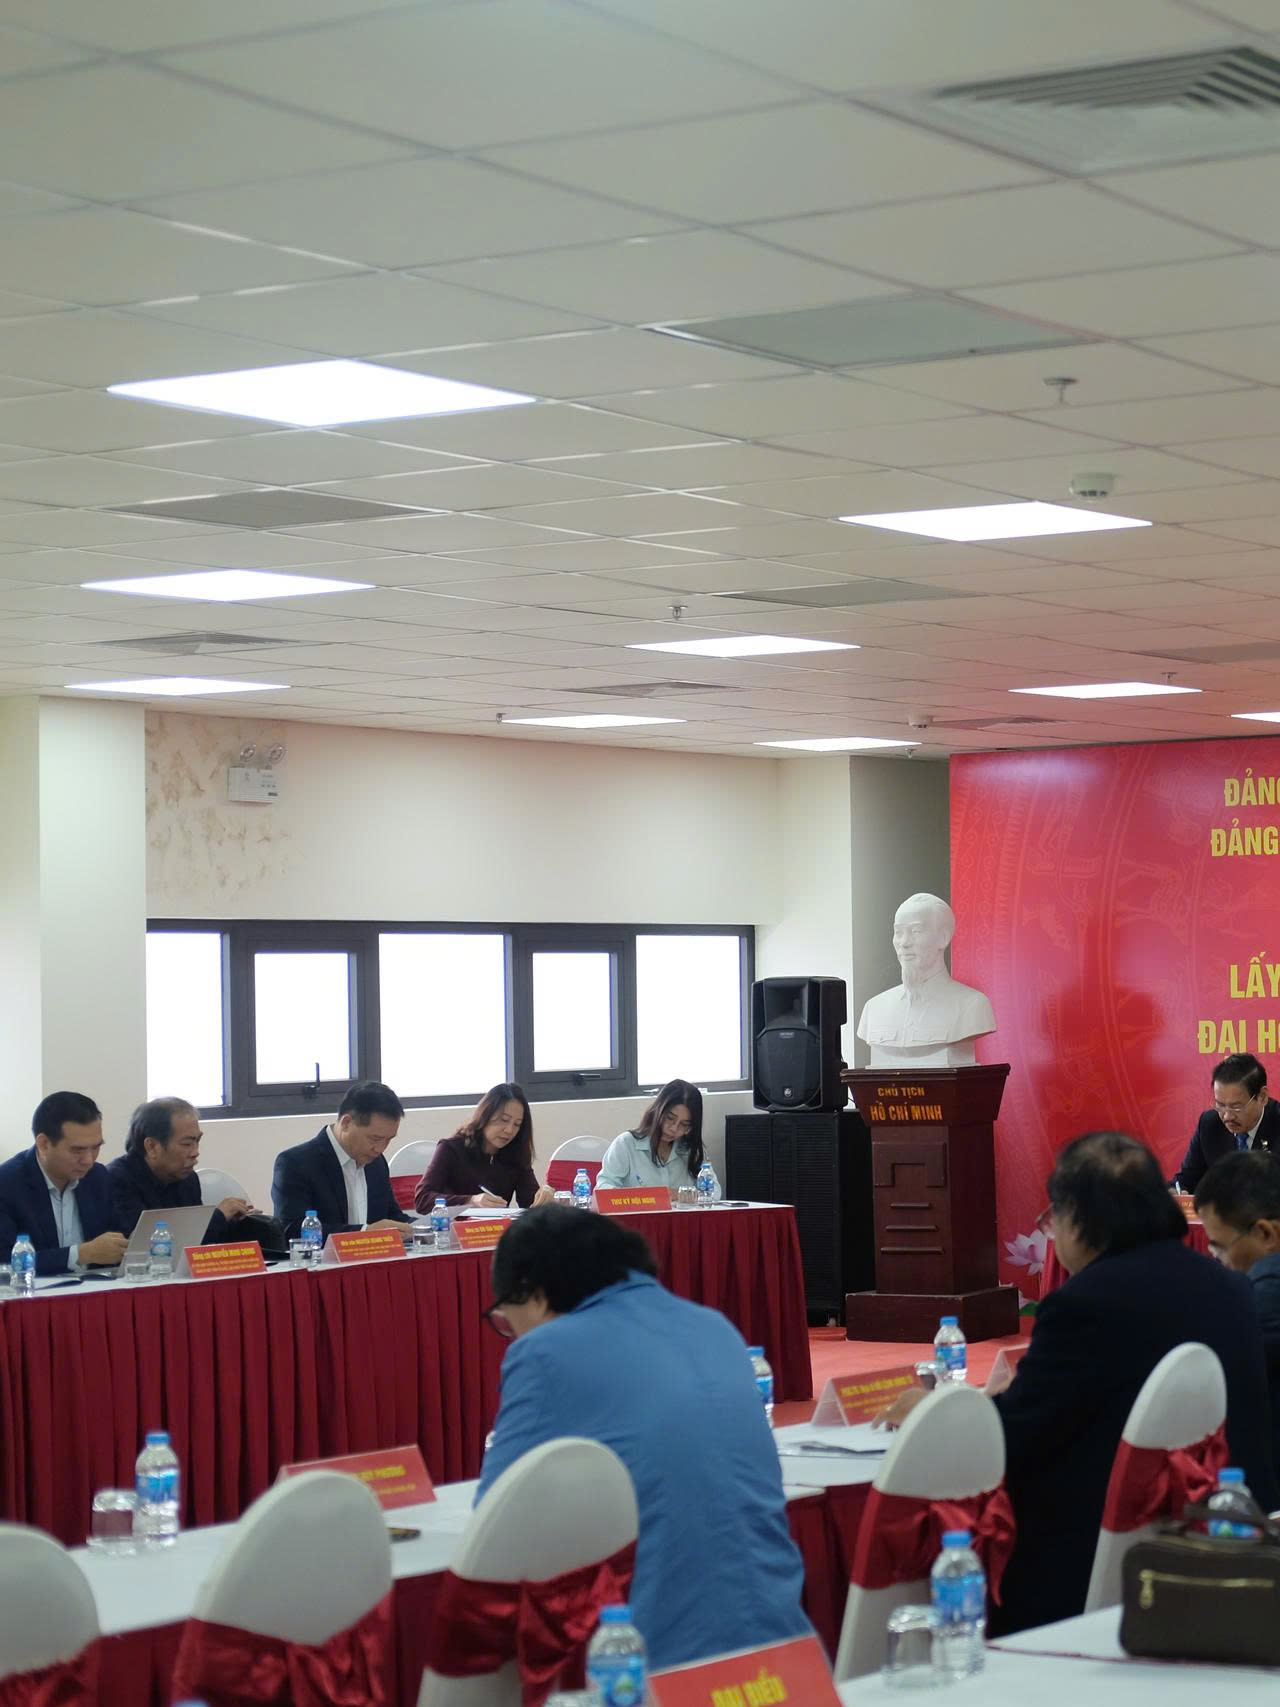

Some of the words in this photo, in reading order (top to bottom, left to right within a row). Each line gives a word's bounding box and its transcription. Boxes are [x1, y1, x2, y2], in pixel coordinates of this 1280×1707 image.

[1211, 818, 1278, 856] ĐẢNG
[870, 1100, 886, 1120] HỒ
[888, 1101, 909, 1120] CHÍ
[911, 1105, 943, 1120] MINH
